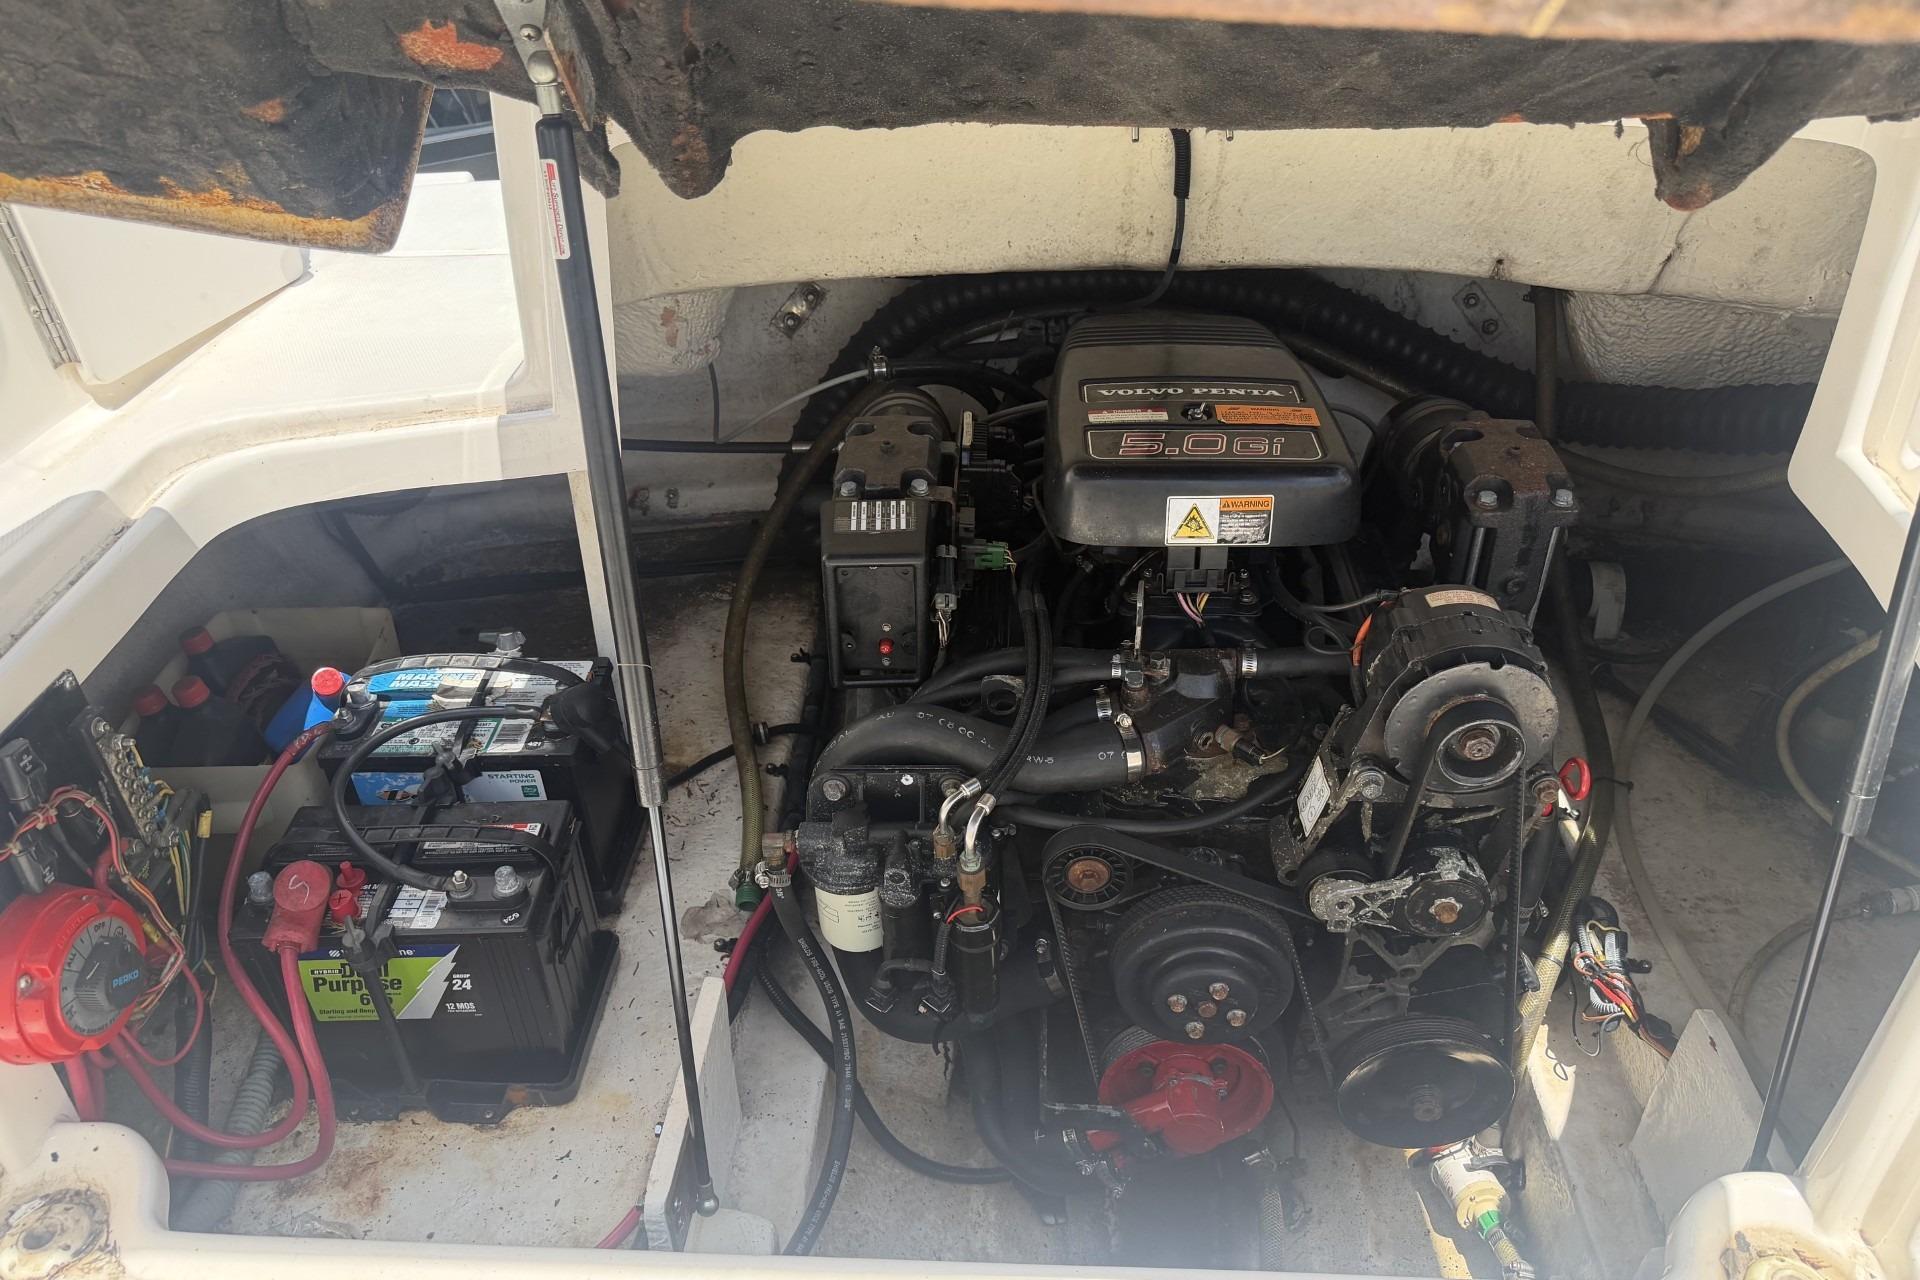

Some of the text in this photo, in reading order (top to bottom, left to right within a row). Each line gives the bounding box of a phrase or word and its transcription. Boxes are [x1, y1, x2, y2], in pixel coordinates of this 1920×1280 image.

[1098, 387, 1286, 396] VOLVO PENTA
[1231, 500, 1270, 508] WARNING
[94, 921, 106, 933] OFF
[67, 952, 77, 968] ALL
[112, 969, 139, 989] PERKO
[452, 979, 472, 991] 24
[313, 977, 402, 995] Purpse
[456, 1002, 476, 1010] MOS
[830, 994, 841, 1009] TYPE
